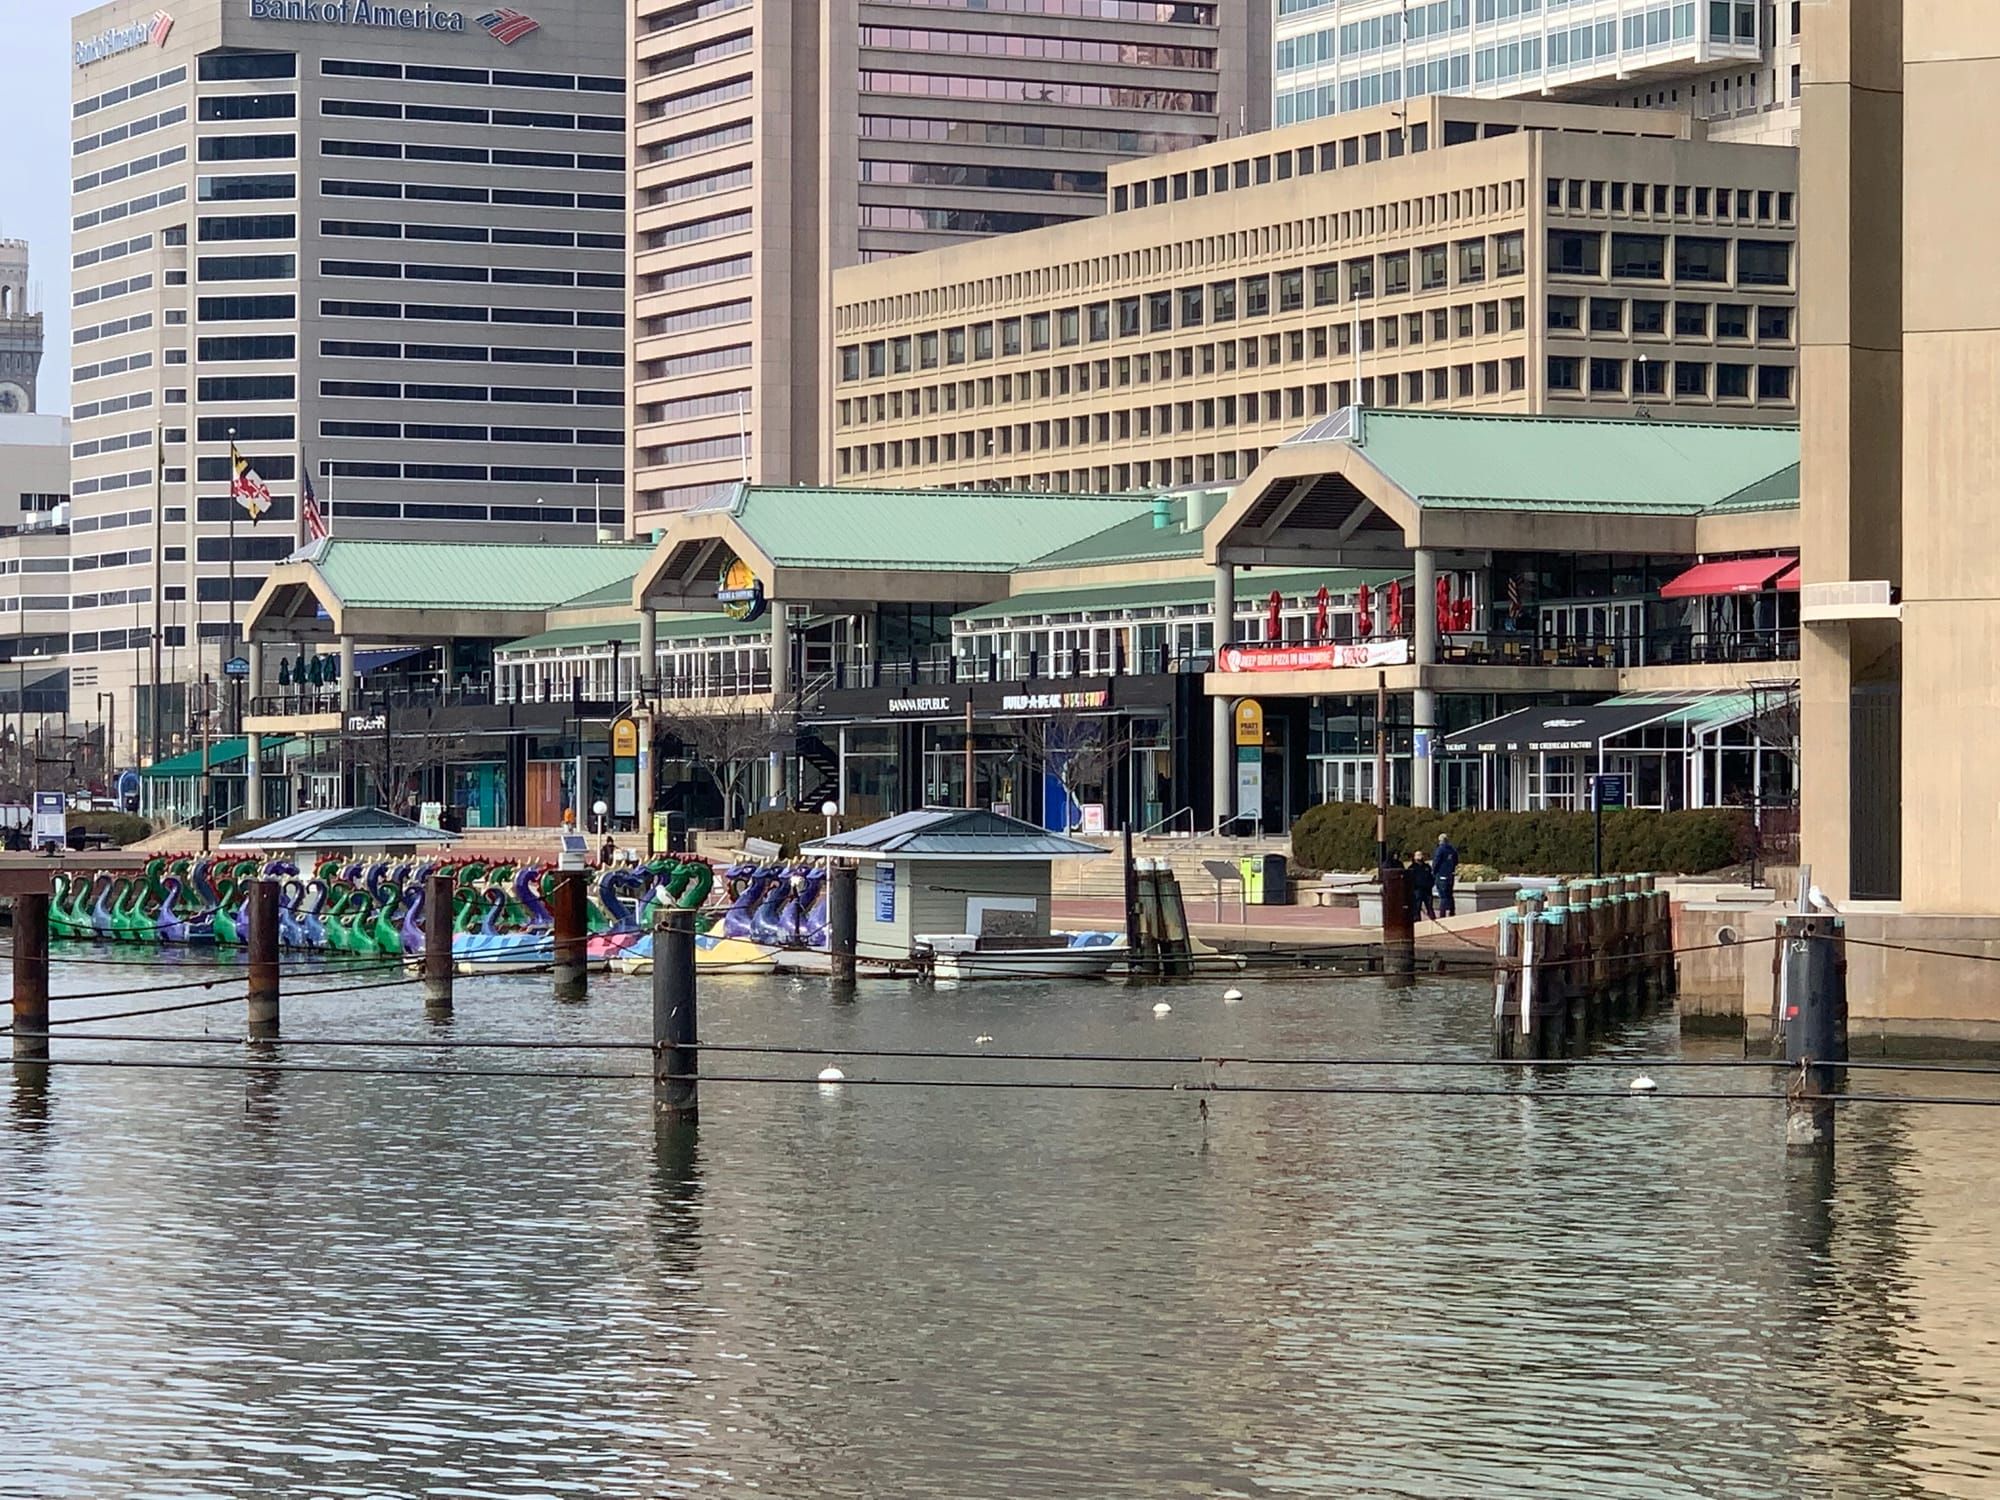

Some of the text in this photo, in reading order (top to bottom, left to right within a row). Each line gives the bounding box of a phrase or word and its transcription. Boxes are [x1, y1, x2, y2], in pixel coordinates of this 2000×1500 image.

[249, 0, 464, 31] Bank of America
[1273, 653, 1290, 666] PIZZA
[1290, 652, 1298, 665] IN
[889, 697, 950, 712] BANANA REPUBLIC
[1790, 939, 1808, 956] R2
